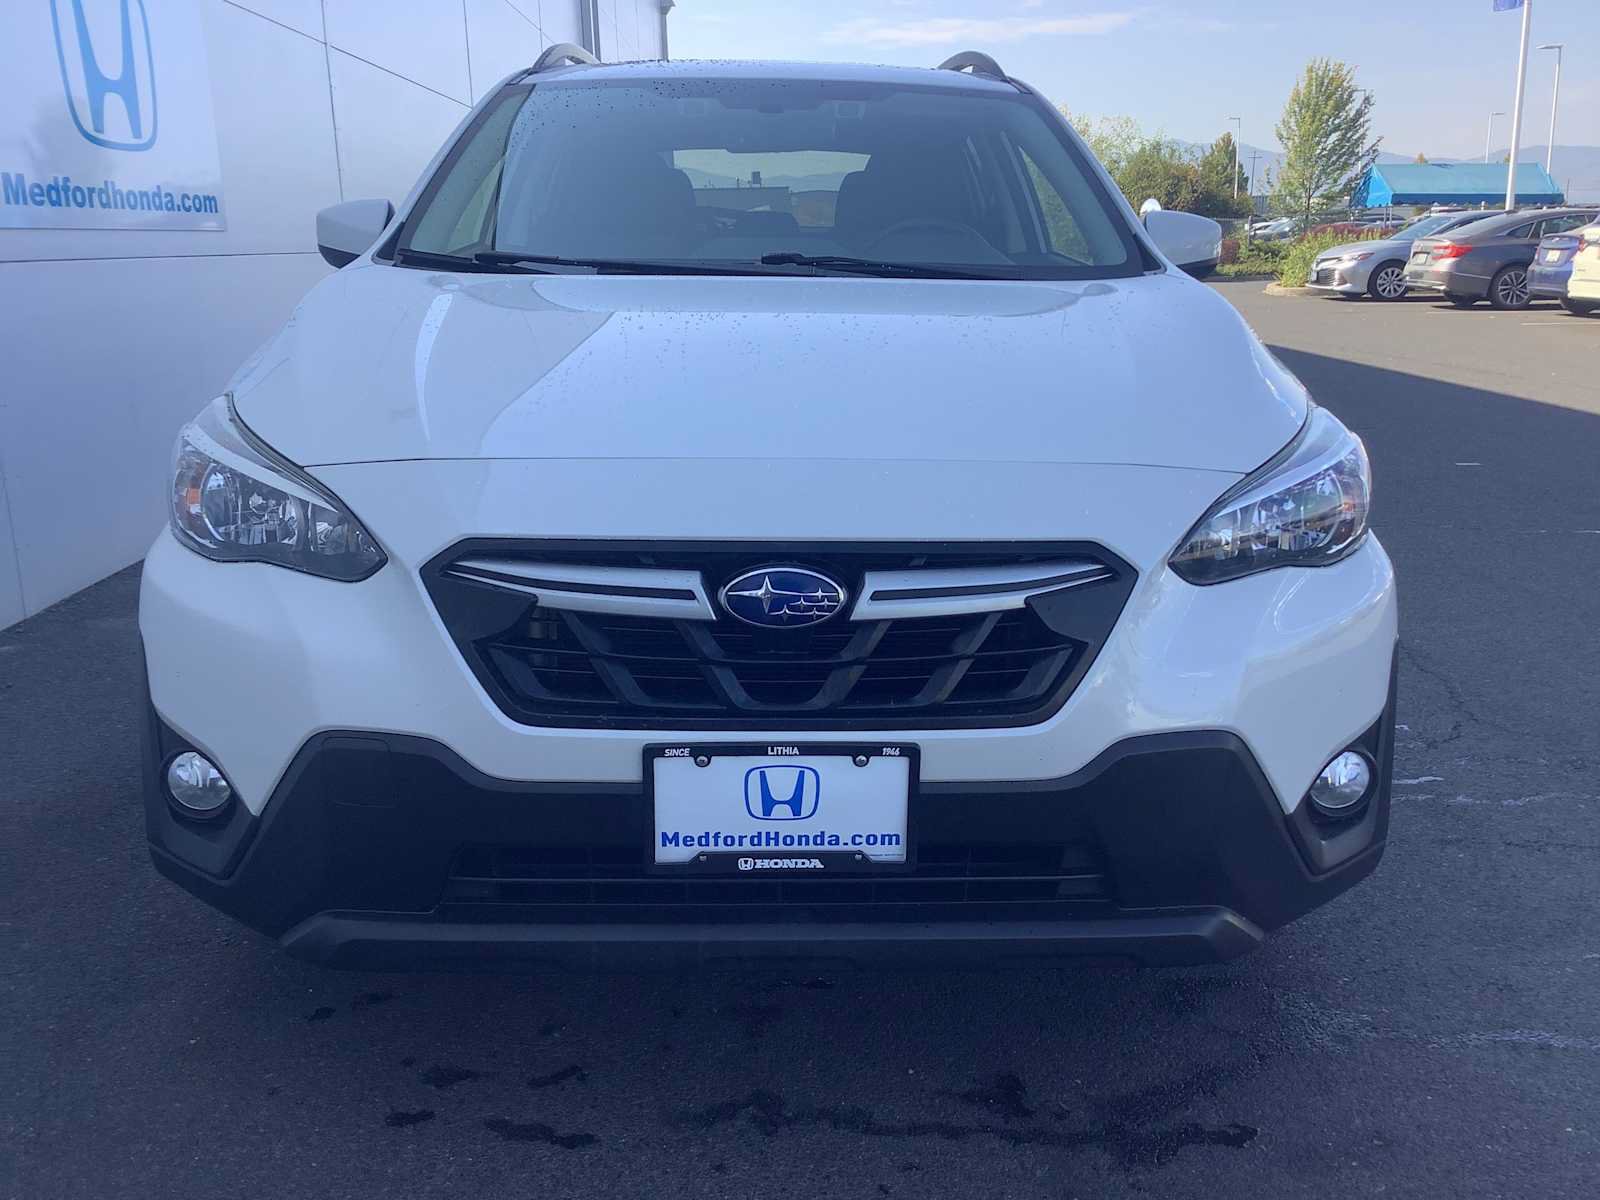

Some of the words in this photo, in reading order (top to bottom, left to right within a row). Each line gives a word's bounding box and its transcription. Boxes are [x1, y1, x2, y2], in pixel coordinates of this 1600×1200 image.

[1, 172, 219, 213] Medfordhonda.com
[664, 748, 691, 757] SINCE
[767, 746, 800, 756] LITHIA
[661, 831, 901, 848] MedfordHonda.com
[755, 858, 825, 869] HONDA
